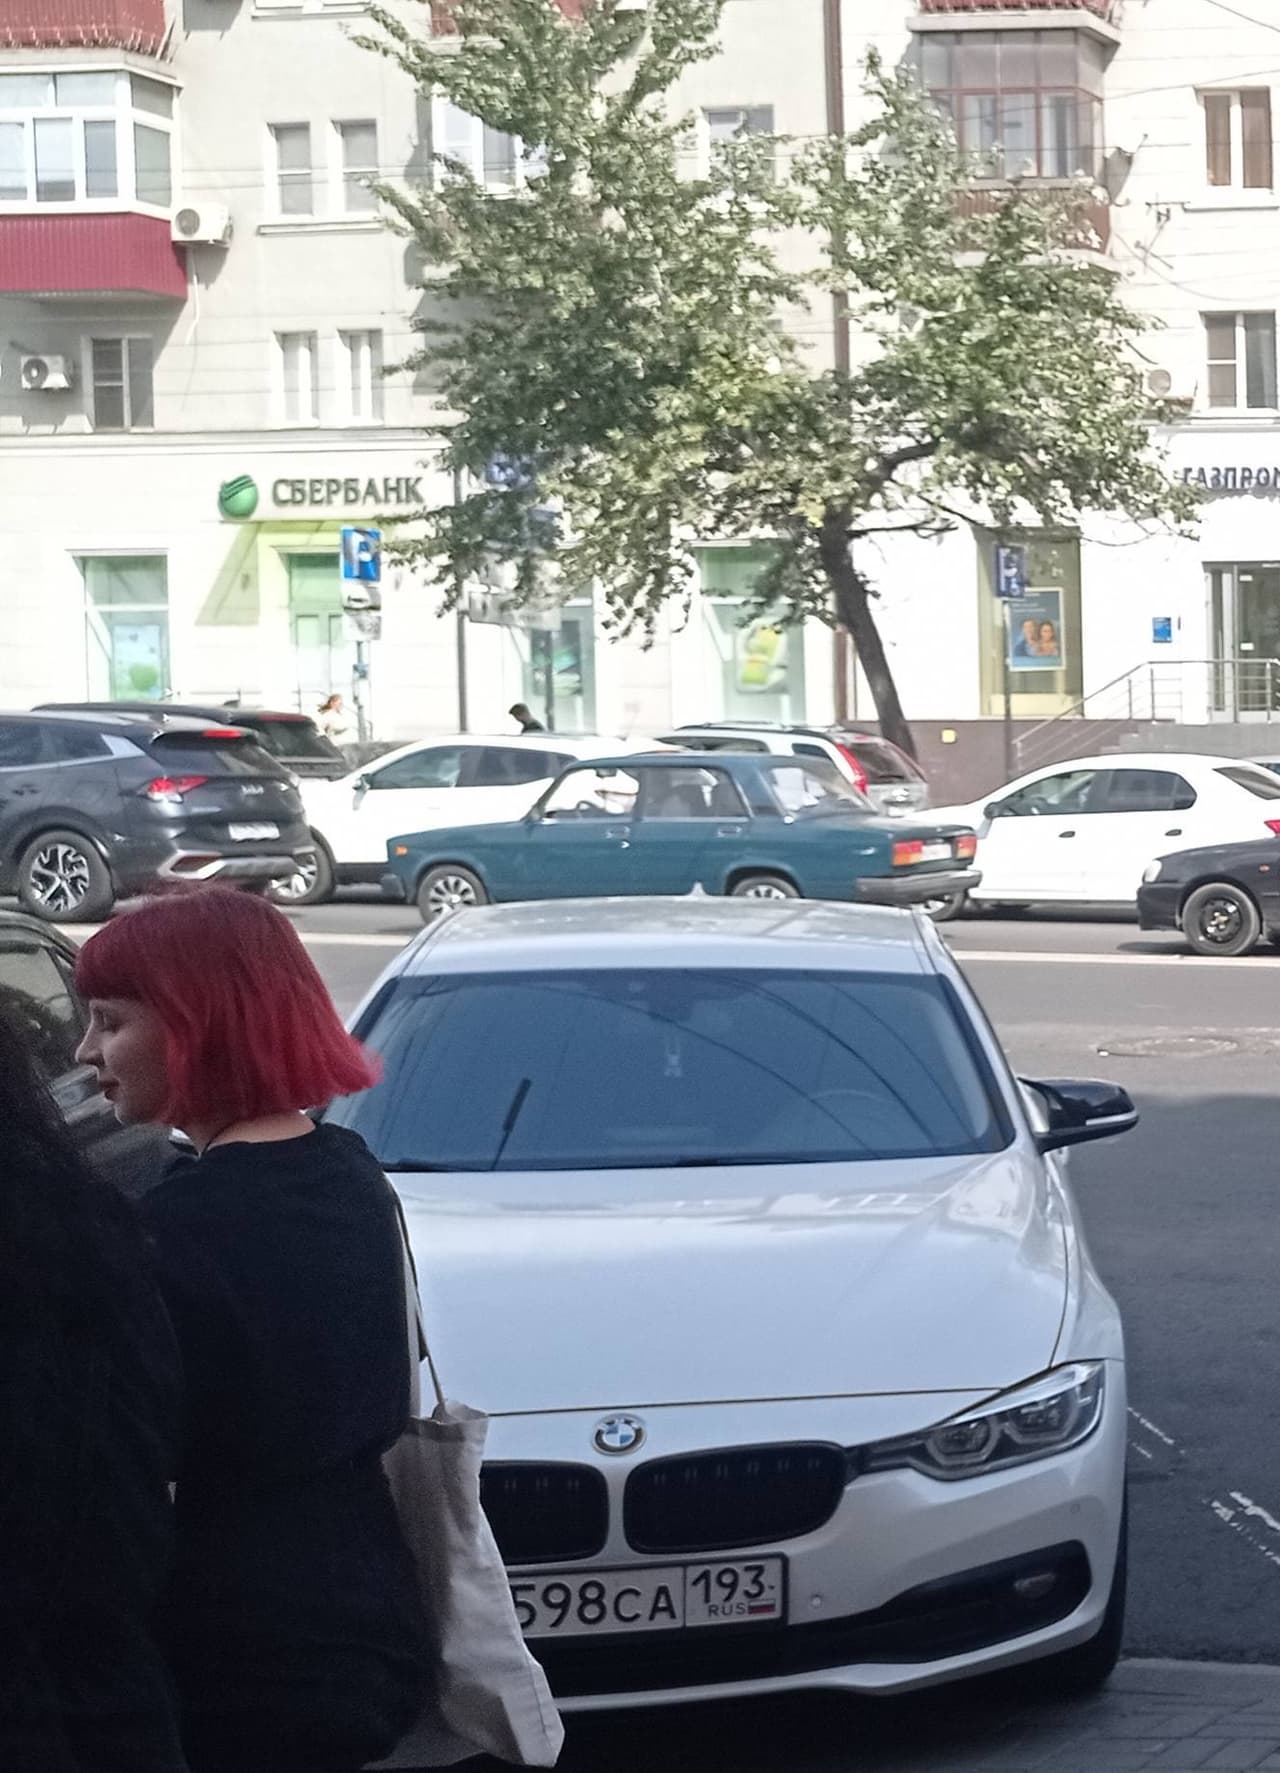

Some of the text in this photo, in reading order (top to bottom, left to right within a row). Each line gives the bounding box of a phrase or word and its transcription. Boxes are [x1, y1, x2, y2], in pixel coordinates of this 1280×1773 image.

[272, 477, 423, 506] СБЕРБАНК
[691, 1565, 766, 1604] 193
[708, 1602, 747, 1617] RUS
